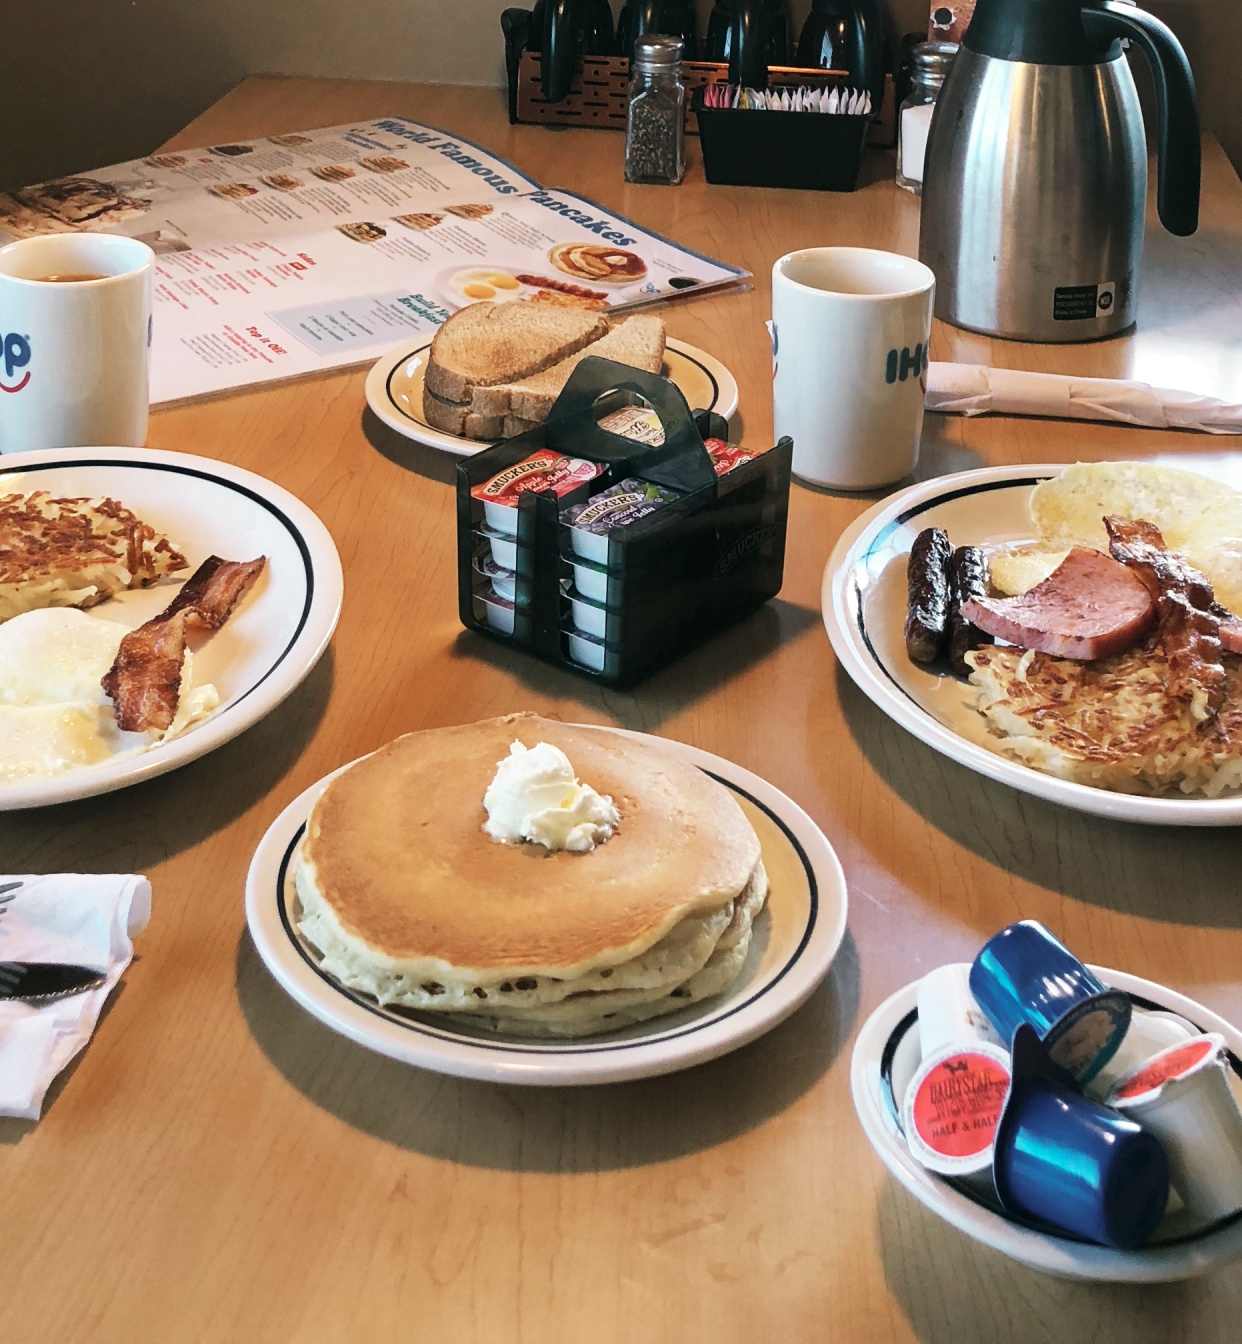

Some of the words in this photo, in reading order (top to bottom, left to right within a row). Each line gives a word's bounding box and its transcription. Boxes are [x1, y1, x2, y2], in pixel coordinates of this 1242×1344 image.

[372, 120, 441, 144] World
[427, 142, 519, 194] Famous
[517, 190, 638, 247] Pancakes
[886, 340, 929, 384] IH
[487, 460, 547, 495] SMUCKER'S
[515, 476, 543, 492] Apple
[579, 494, 638, 523] SMUCKER'S
[932, 1122, 958, 1137] HALF
[962, 1121, 970, 1131] &
